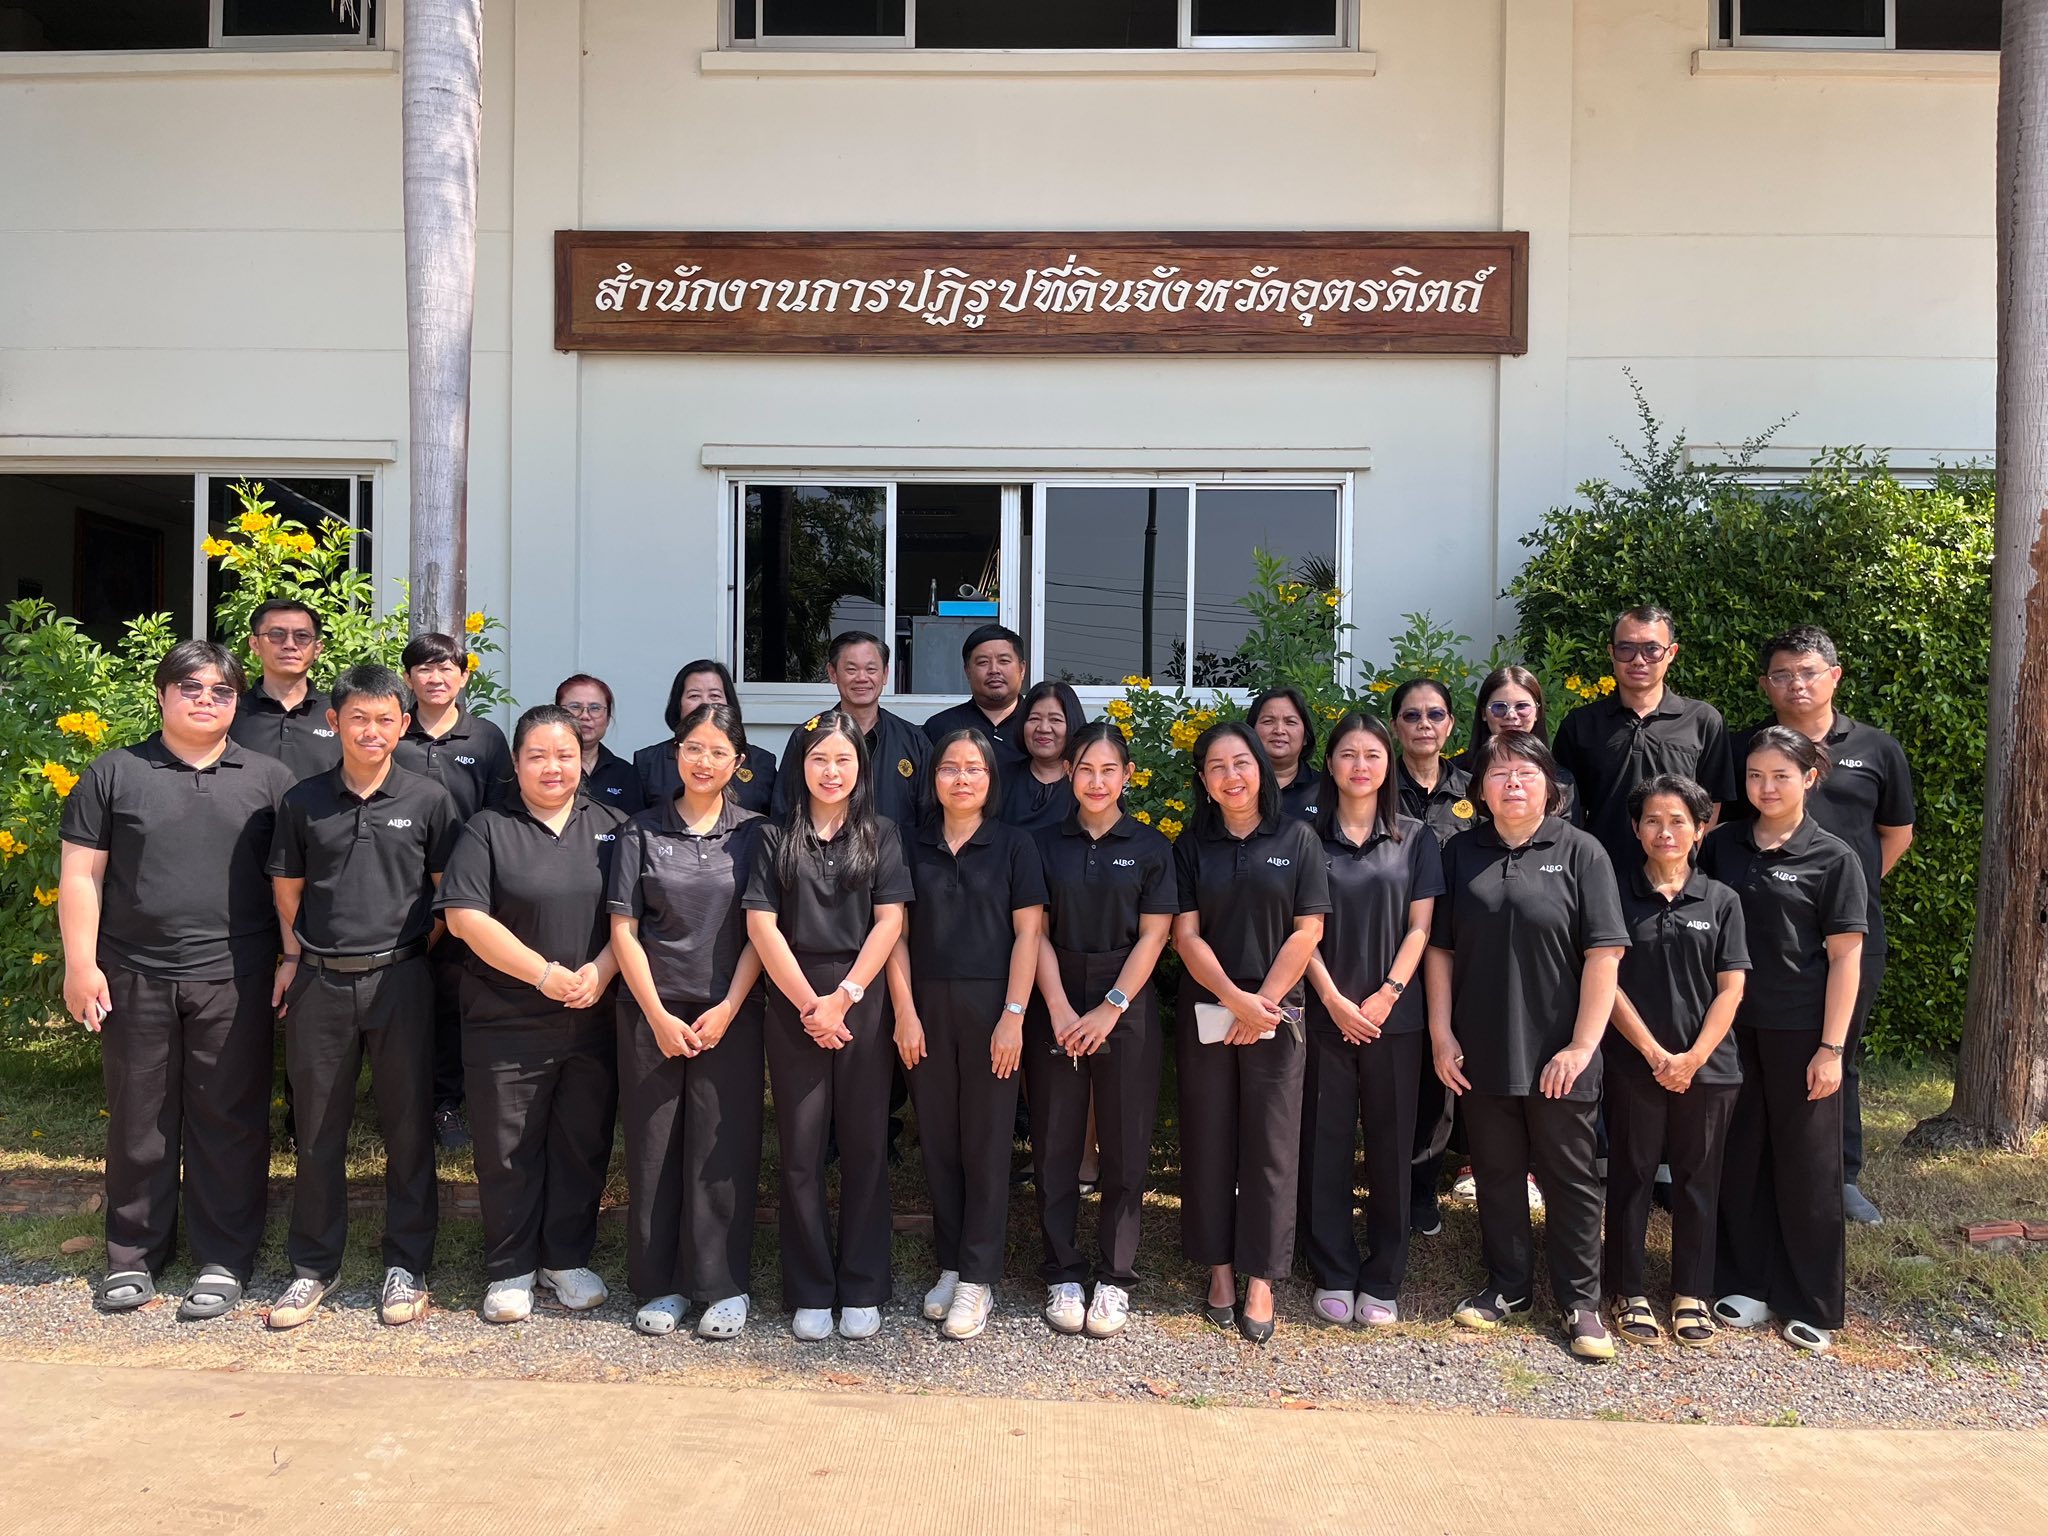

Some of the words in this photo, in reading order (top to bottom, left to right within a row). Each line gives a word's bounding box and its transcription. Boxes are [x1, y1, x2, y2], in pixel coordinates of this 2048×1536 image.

[595, 253, 1497, 328] สำนักงานการปฏิรูปที่ดินจังหวัดอุตรดิตถ์
